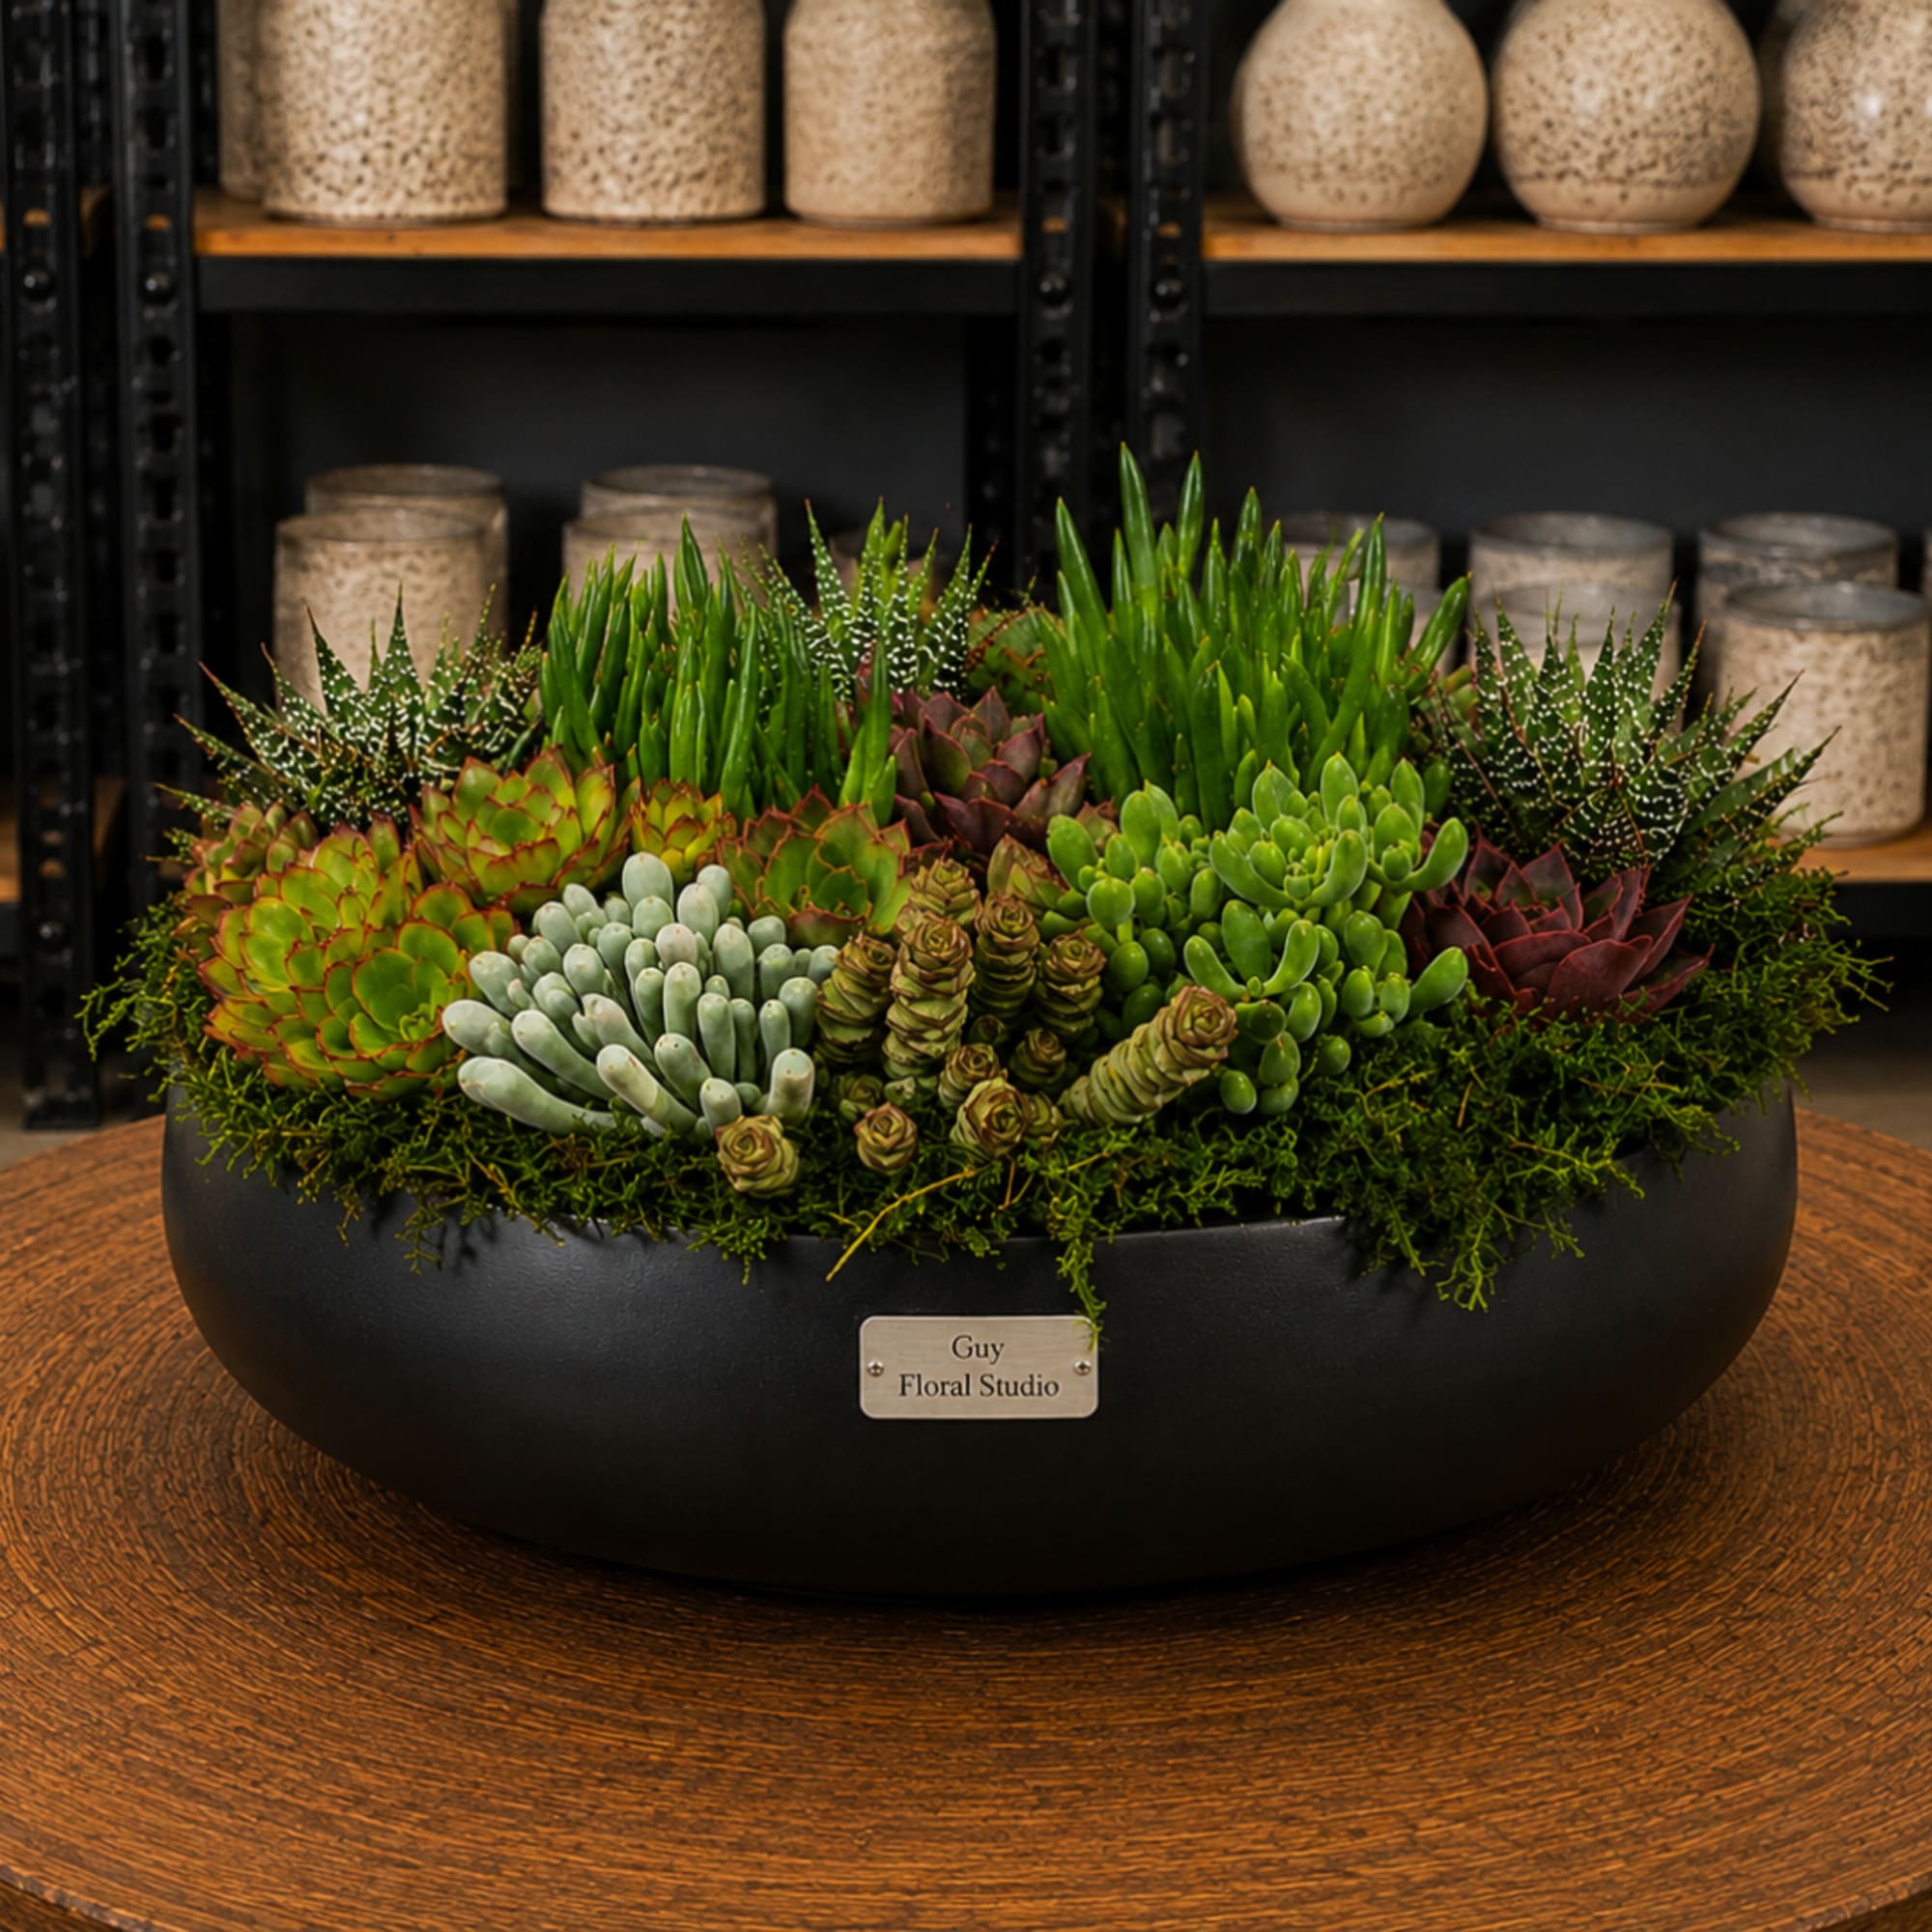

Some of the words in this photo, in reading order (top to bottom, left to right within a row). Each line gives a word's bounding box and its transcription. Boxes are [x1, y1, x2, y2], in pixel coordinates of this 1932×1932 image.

[952, 1334, 1006, 1365] Guy
[899, 1373, 971, 1397] Floral
[980, 1373, 1060, 1397] Studio
